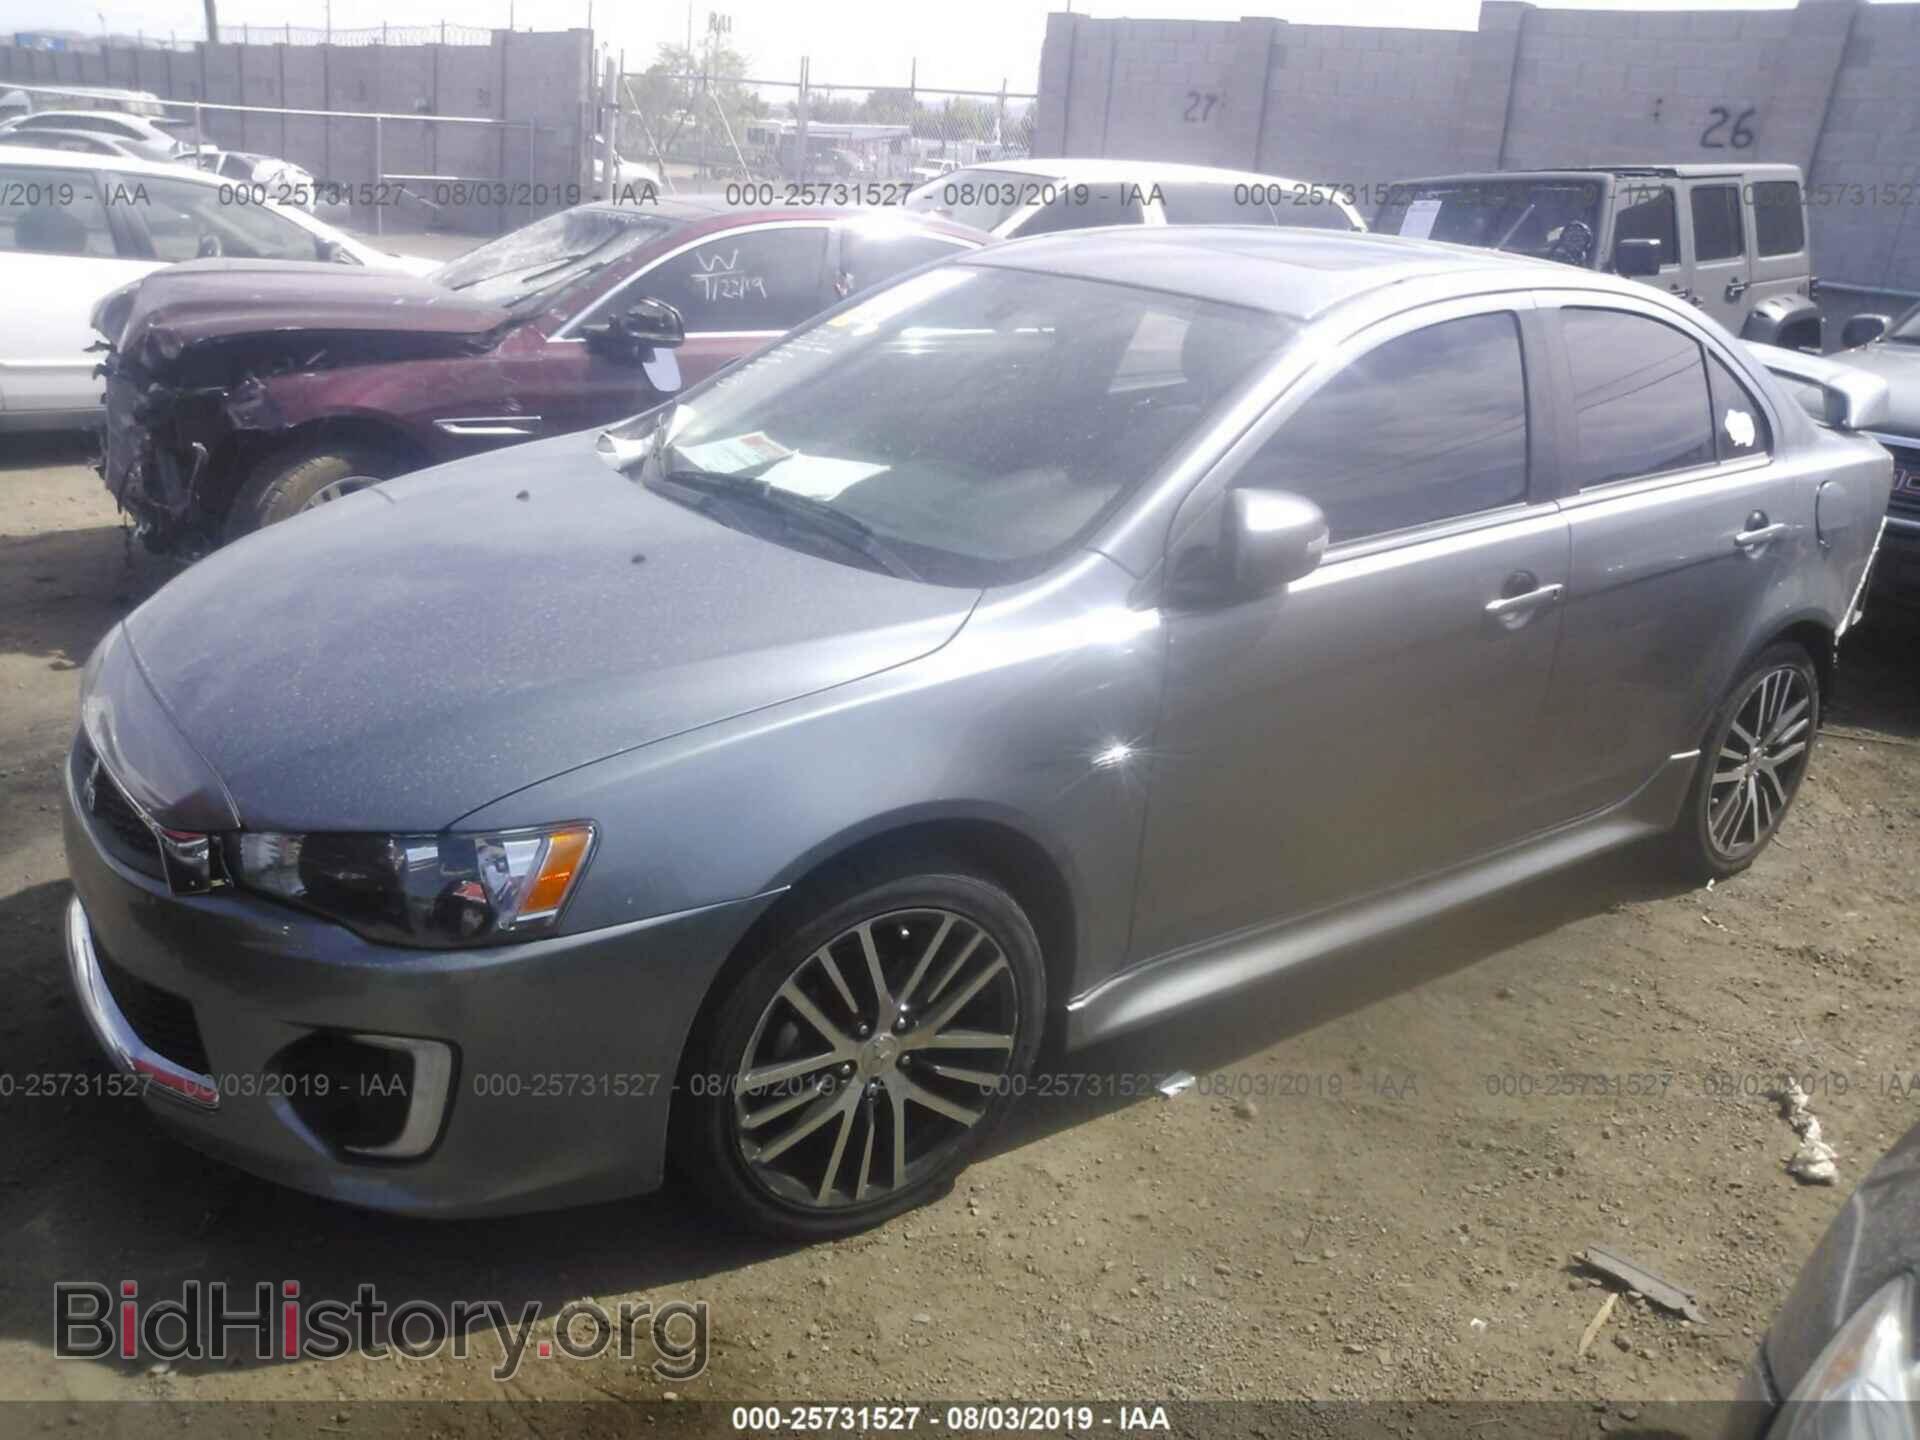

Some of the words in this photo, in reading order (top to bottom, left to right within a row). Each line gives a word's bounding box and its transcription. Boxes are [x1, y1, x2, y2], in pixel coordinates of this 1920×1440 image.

[1184, 90, 1218, 123] 27
[1699, 106, 1757, 149] 26
[695, 248, 739, 272] W
